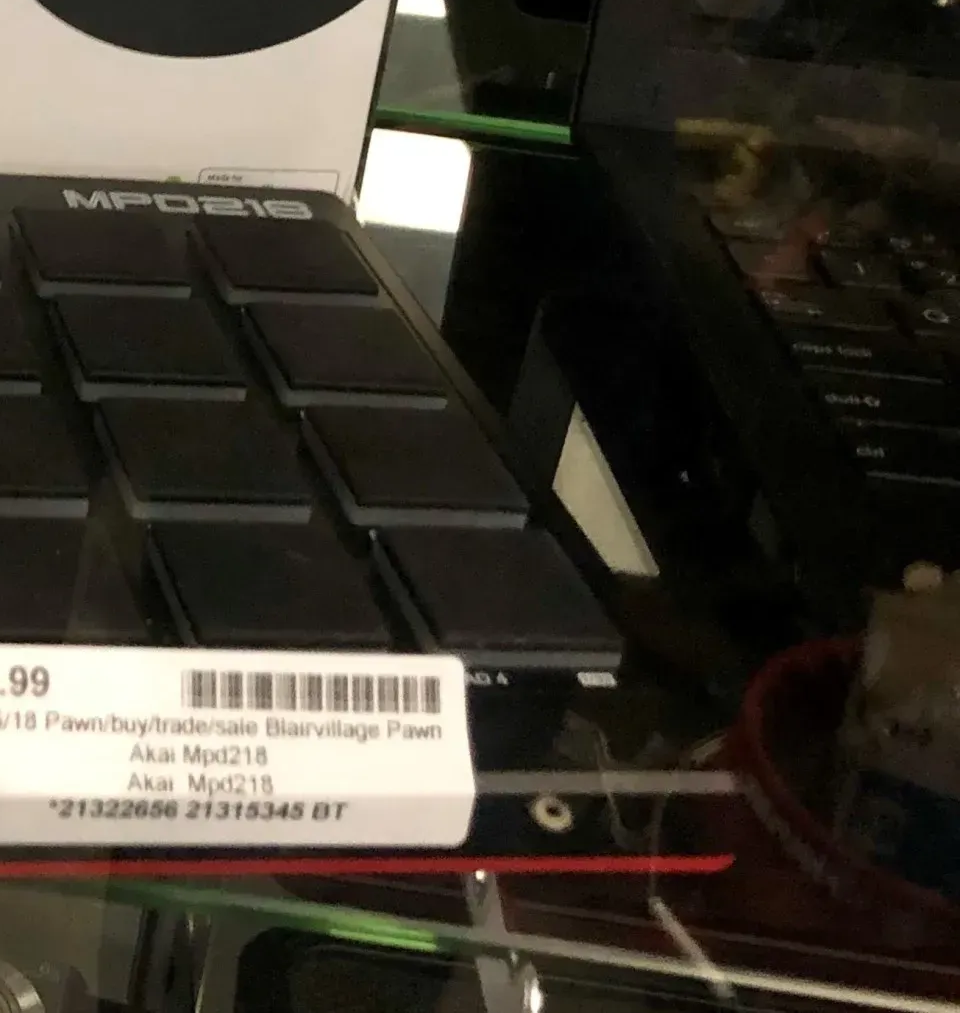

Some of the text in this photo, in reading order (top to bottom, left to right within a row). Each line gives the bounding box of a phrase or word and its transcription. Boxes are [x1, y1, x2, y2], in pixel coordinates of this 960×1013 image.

[62, 189, 313, 220] MPD218
[44, 710, 258, 738] Pawn/buy/trade/sale
[266, 717, 380, 743] Blairvillage
[386, 719, 443, 739] Pawn
[129, 743, 268, 767] Akai Mpd218
[127, 772, 274, 796] Akai Mpd218
[185, 800, 305, 821] 21315345
